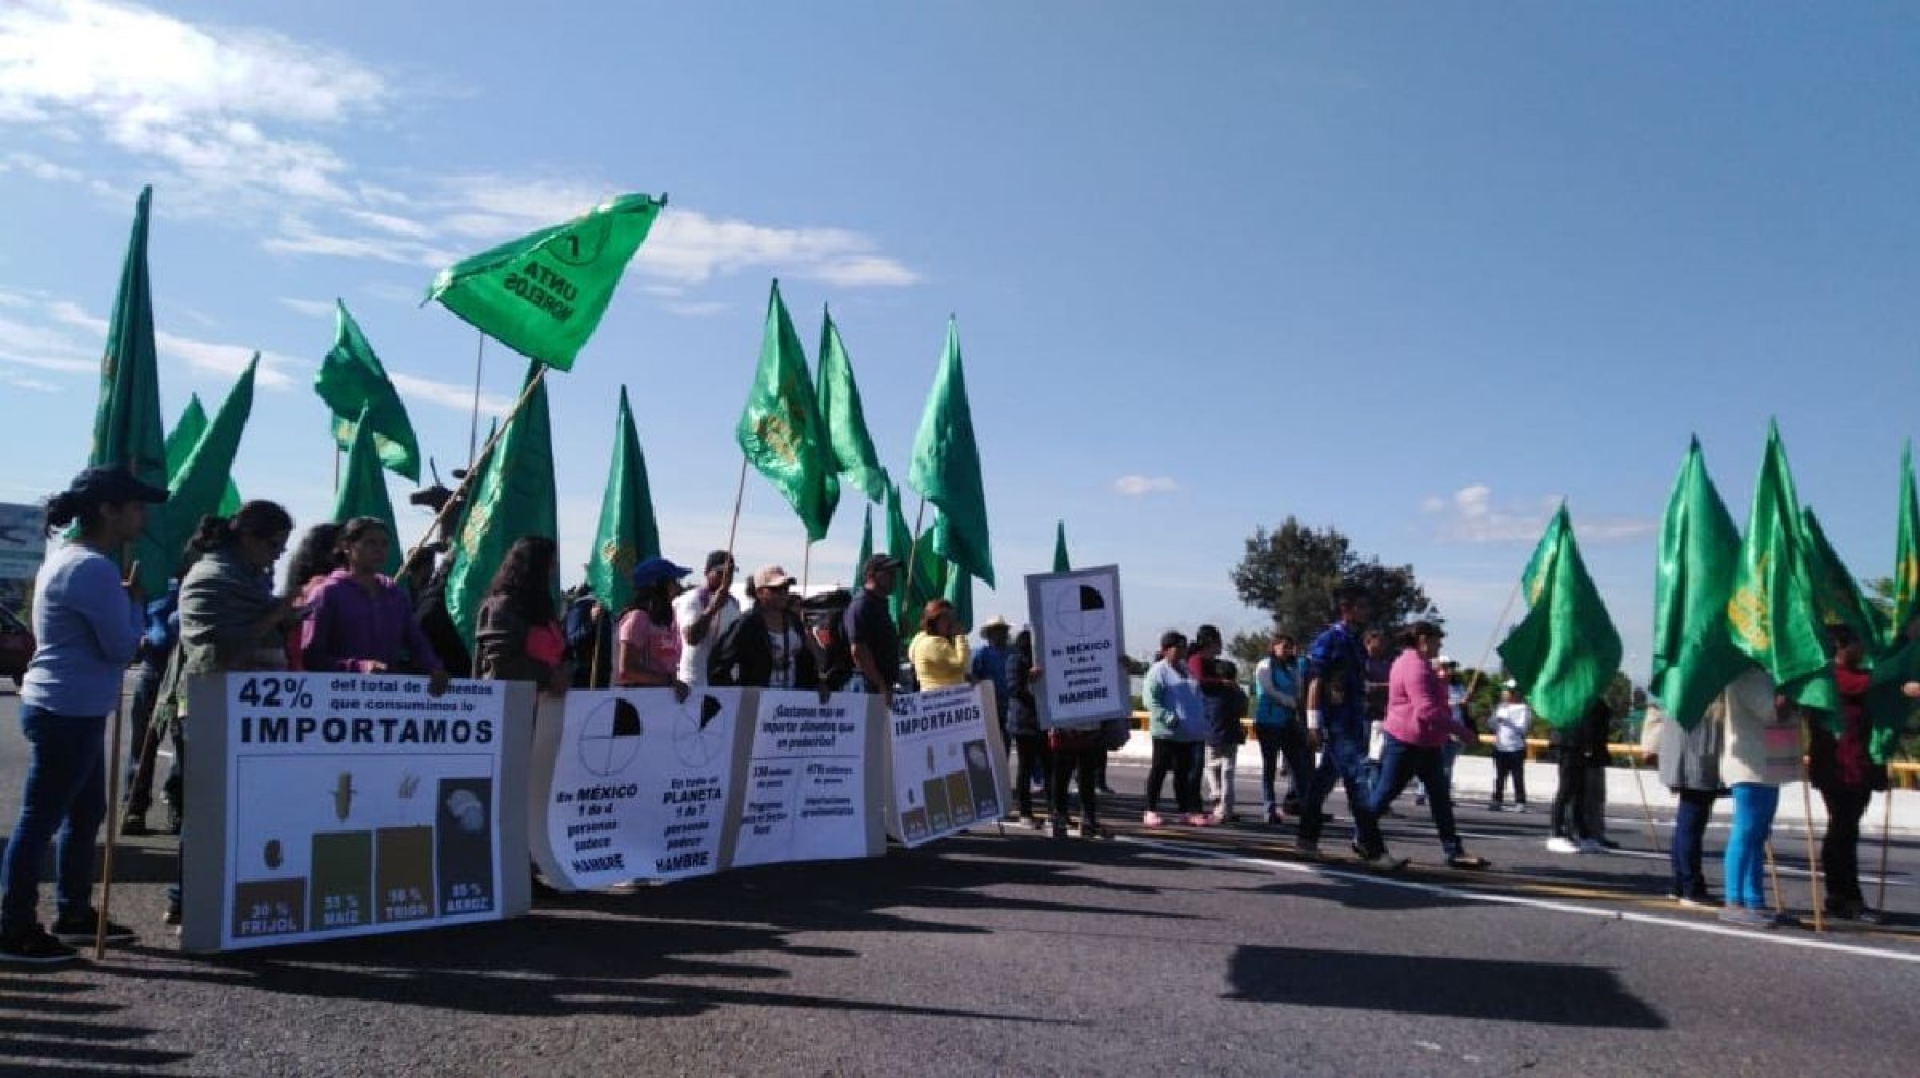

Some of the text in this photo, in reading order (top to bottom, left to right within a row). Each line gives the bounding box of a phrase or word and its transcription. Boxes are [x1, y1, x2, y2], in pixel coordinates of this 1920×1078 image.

[238, 677, 313, 709] 42%
[361, 678, 399, 693] total
[403, 680, 421, 694] de
[330, 699, 360, 711] que
[365, 700, 457, 712] consumimos
[241, 717, 493, 744] IMPORTAMOS
[895, 704, 980, 737] IMPORTAMOS
[663, 787, 721, 805] PLANETA
[656, 851, 709, 873] HAMBRE
[241, 917, 297, 935] FRIJOL
